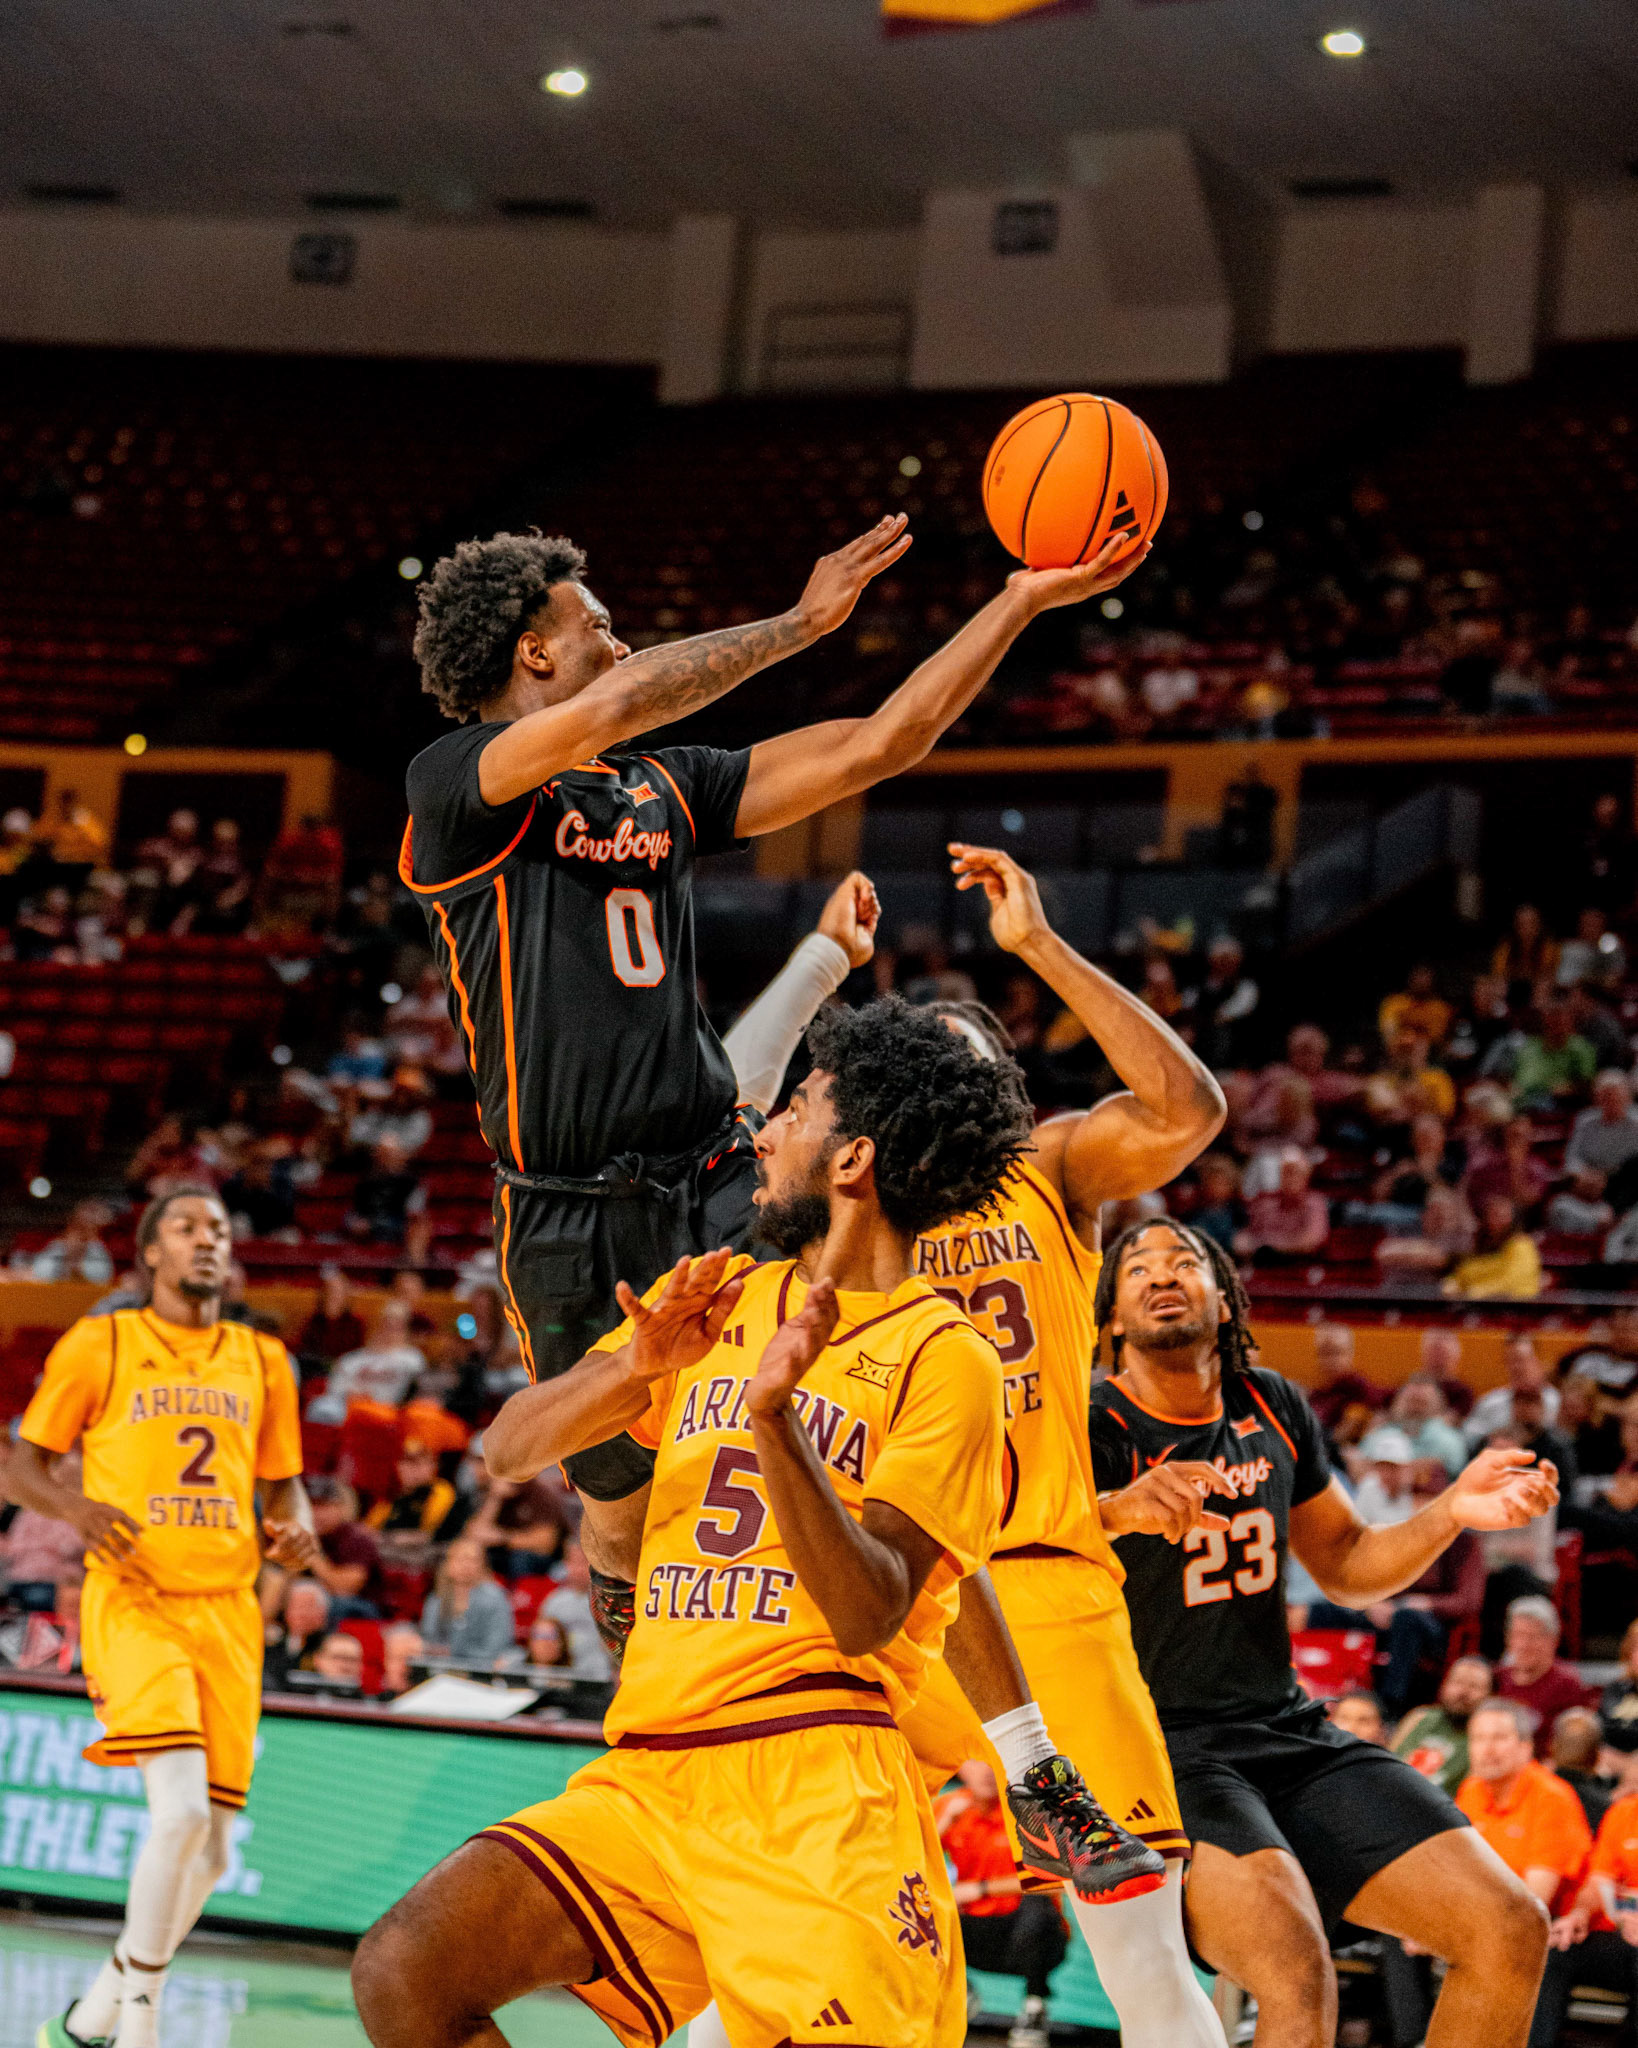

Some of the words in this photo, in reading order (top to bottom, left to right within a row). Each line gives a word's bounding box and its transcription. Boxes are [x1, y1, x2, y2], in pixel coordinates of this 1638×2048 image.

[555, 810, 673, 871] Cowboys
[605, 888, 666, 987] 0
[915, 1221, 1042, 1278] RIZONA
[177, 1425, 218, 1487] 2
[674, 1375, 869, 1486] ARINA
[148, 1495, 239, 1530] STATE
[695, 1444, 769, 1558] 5
[1183, 1507, 1277, 1608] 23
[645, 1563, 797, 1626] STATE
